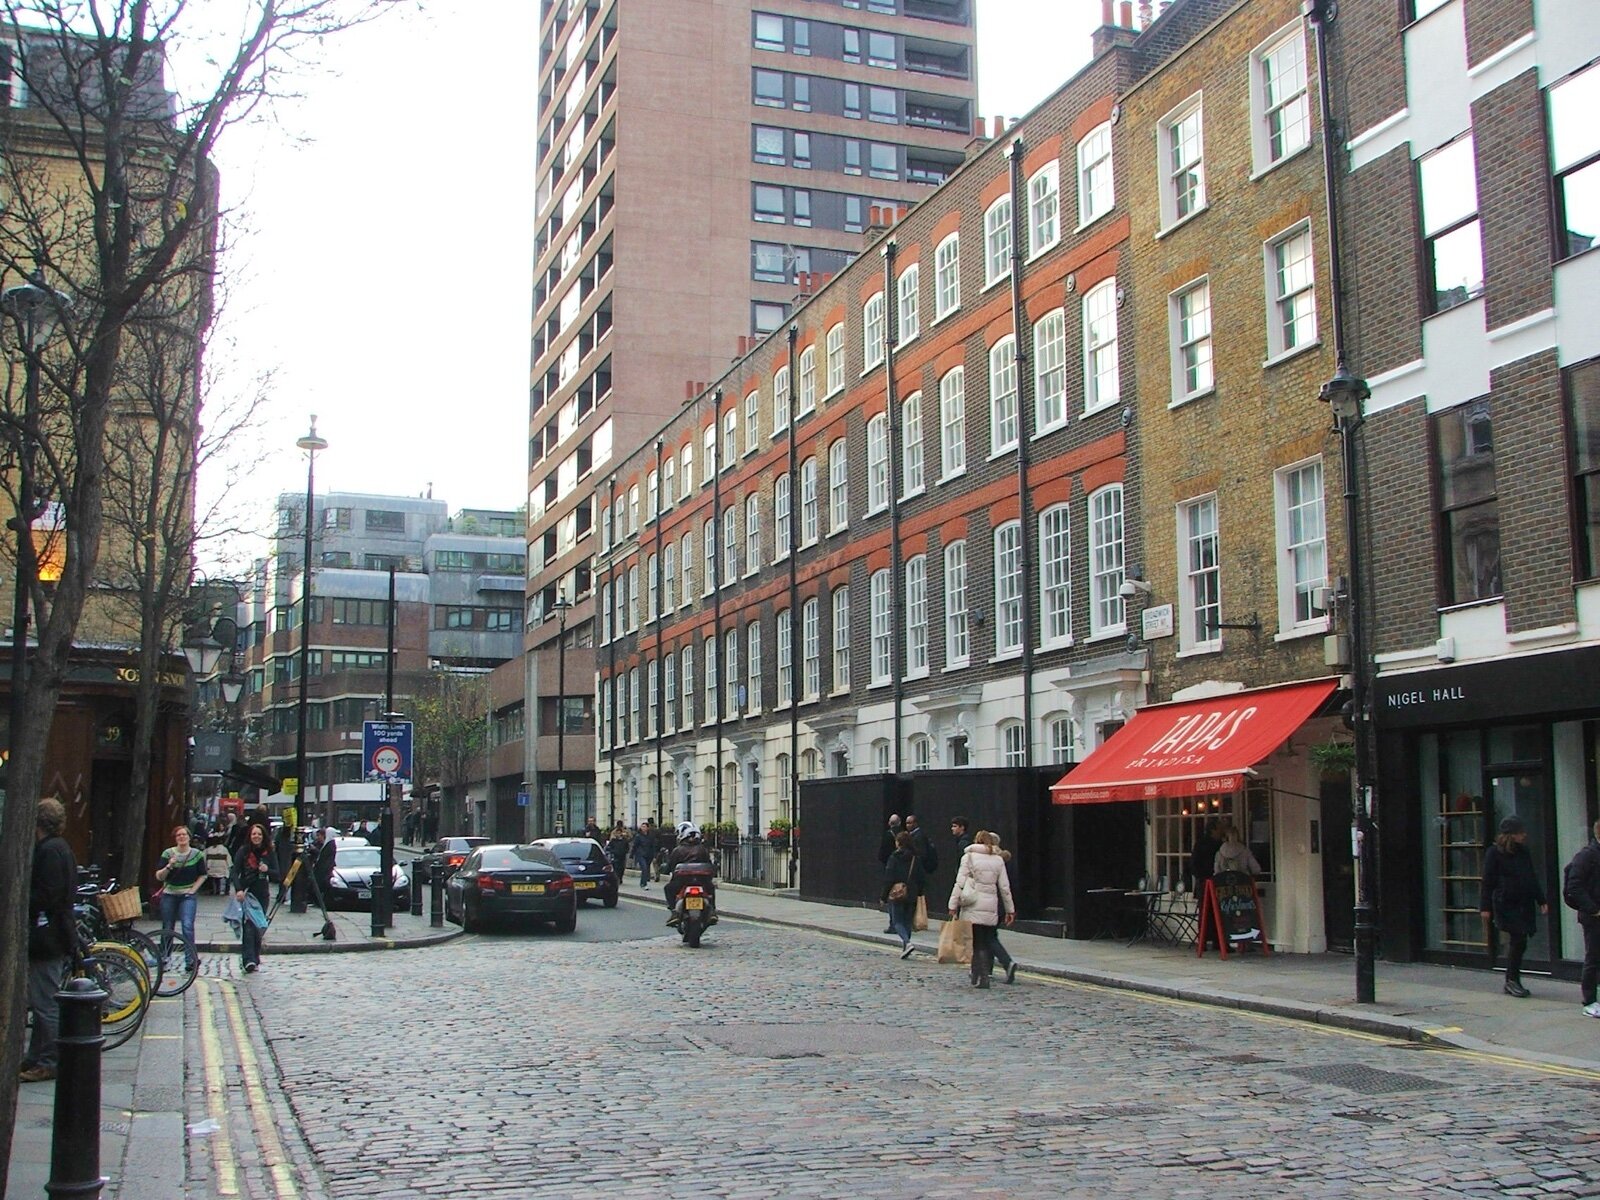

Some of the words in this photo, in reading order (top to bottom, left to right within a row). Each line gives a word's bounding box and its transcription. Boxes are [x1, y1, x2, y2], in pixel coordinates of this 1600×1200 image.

[1388, 691, 1426, 706] NIGEL
[1432, 686, 1465, 701] HALL
[105, 726, 120, 741] 39
[1143, 706, 1257, 756] TAPAS
[1124, 754, 1205, 769] BRINDISA
[1195, 781, 1207, 792] 020
